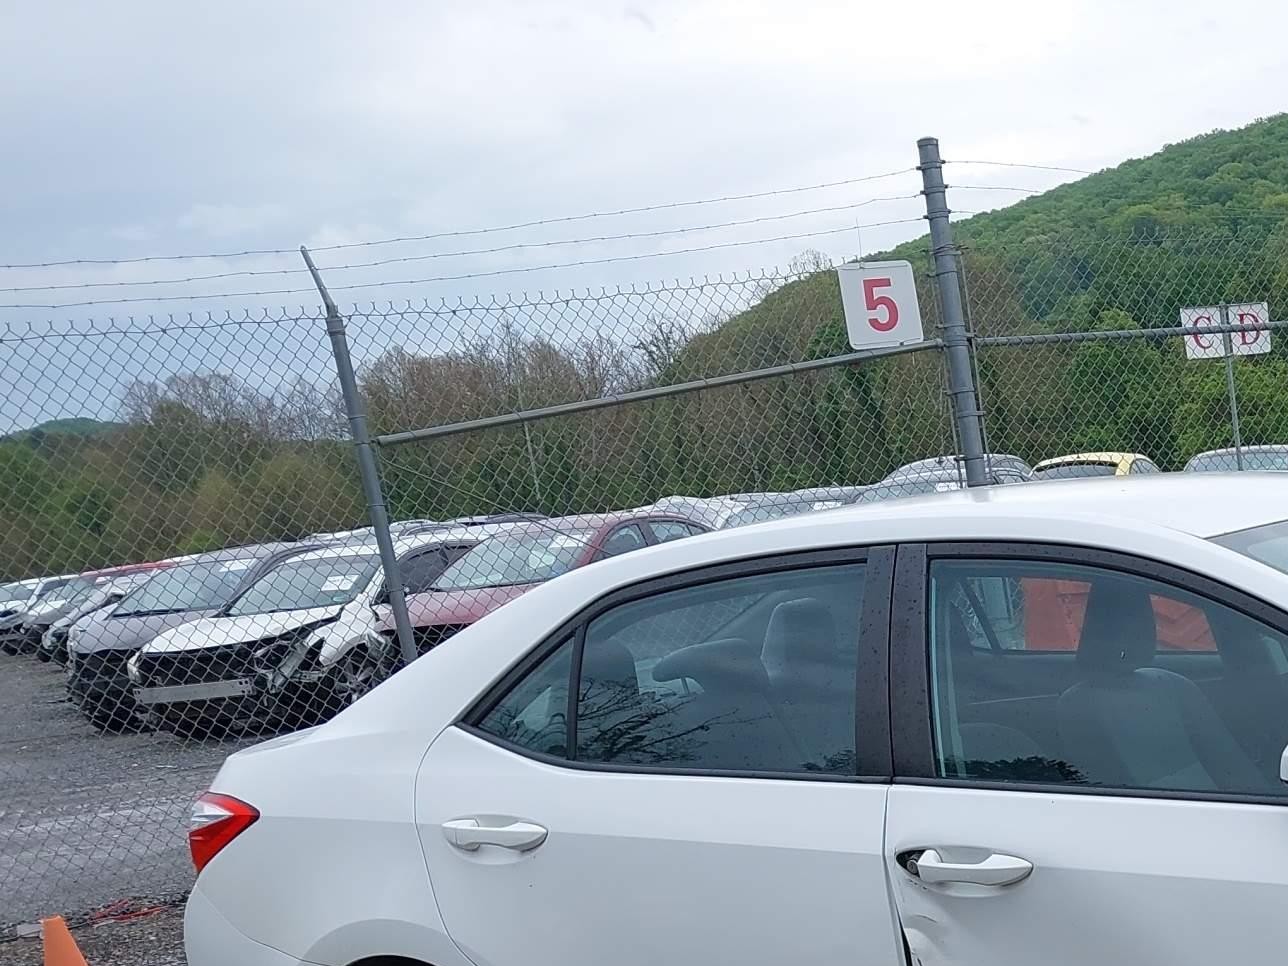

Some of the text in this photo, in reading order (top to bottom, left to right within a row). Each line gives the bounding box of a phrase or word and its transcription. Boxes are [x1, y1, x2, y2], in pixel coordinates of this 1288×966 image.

[863, 278, 899, 332] 5
[1192, 315, 1215, 349] C
[1237, 313, 1260, 345] D
